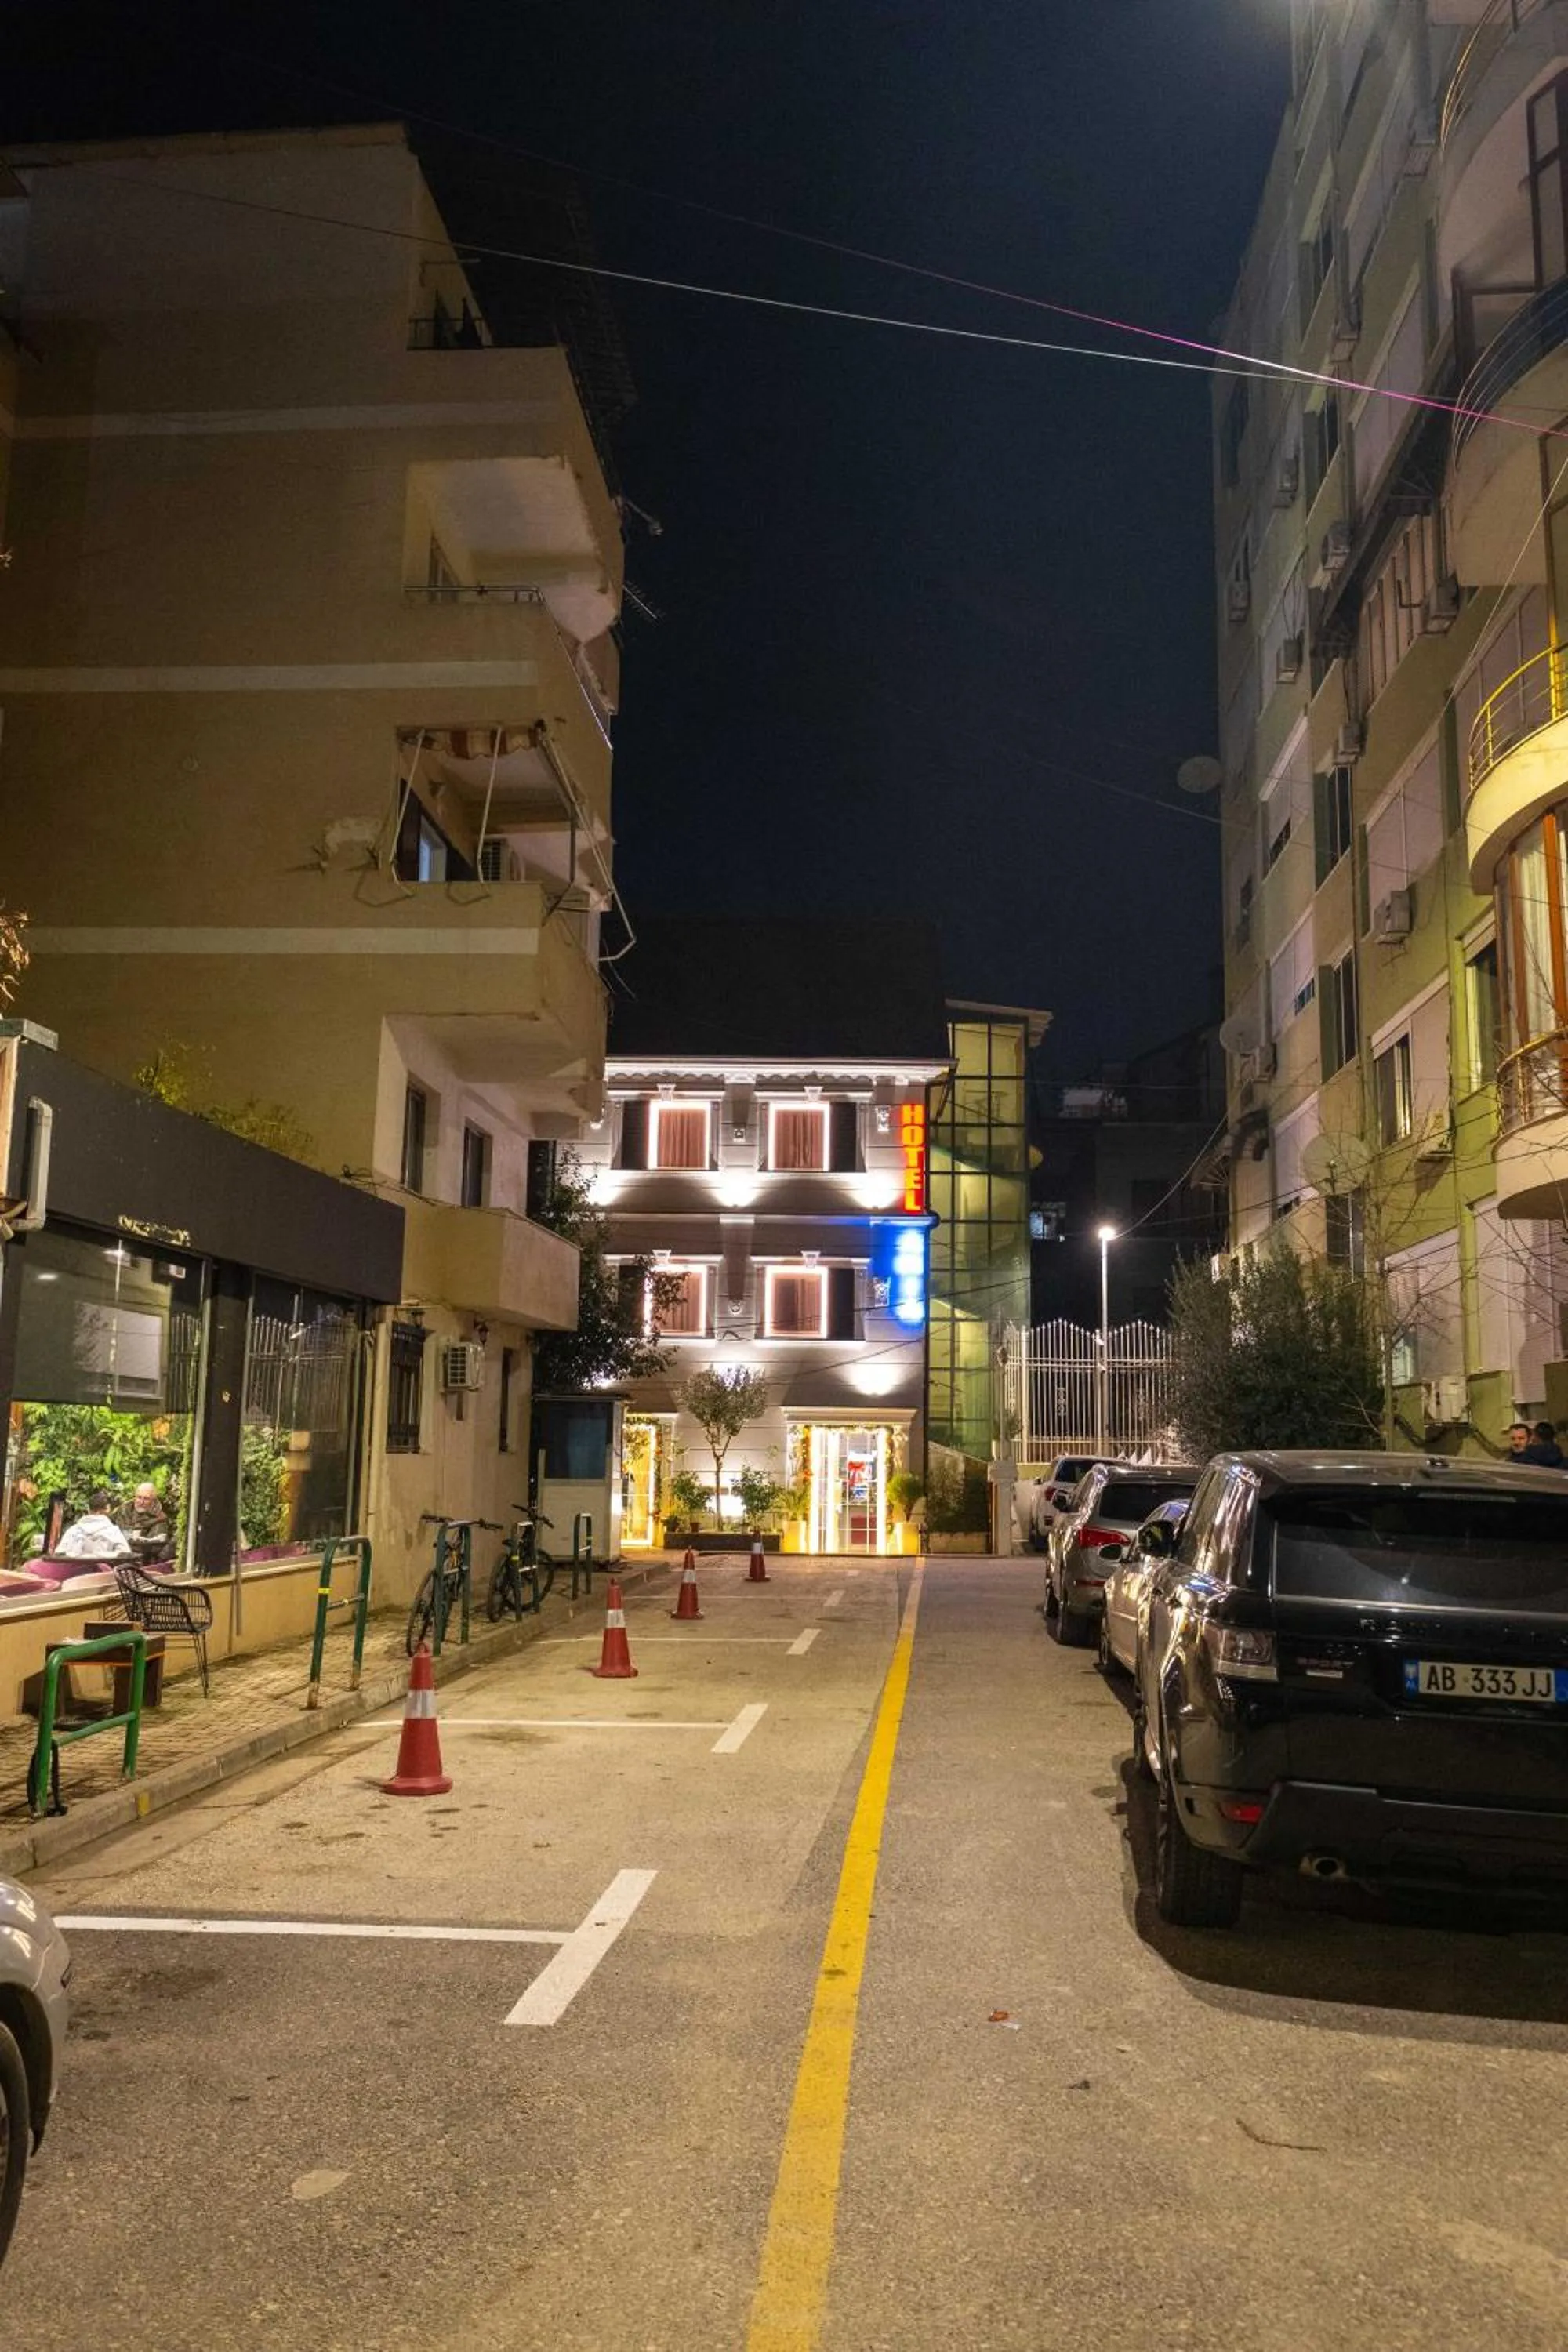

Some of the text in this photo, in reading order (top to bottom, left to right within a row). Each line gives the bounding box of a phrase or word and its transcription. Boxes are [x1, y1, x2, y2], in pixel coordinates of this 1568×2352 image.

[902, 1104, 924, 1210] HOTEL
[1426, 1665, 1552, 1697] AB 333 JJ
